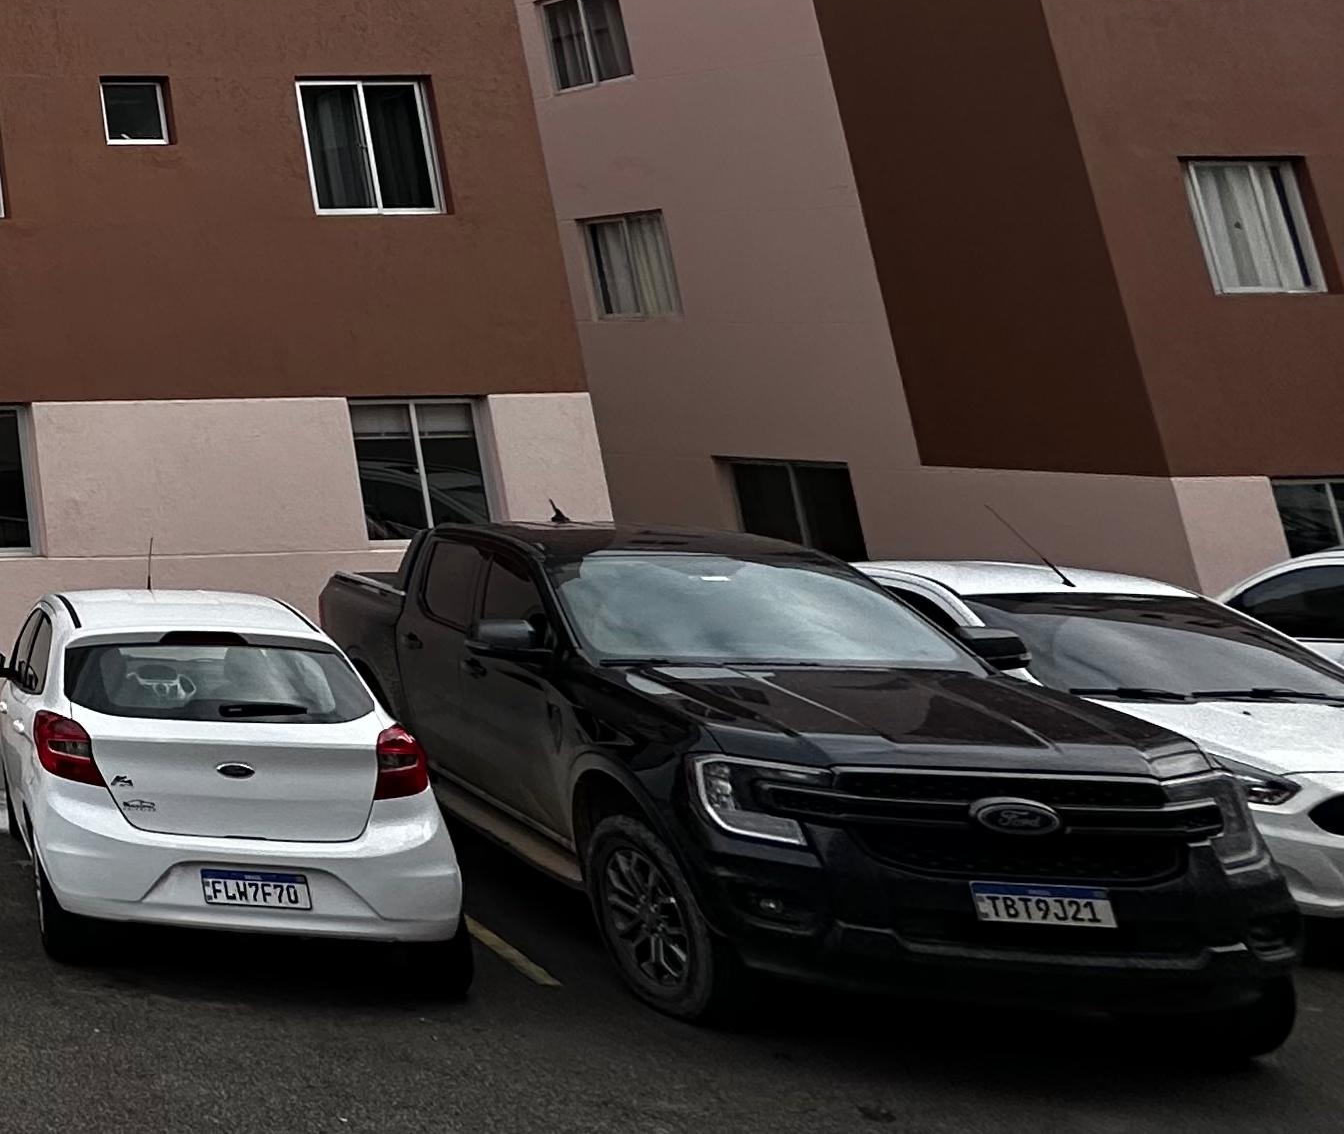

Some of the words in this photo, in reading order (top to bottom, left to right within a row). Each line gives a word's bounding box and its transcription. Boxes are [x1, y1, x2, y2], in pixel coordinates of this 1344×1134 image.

[998, 809, 1041, 827] Ford
[212, 880, 299, 905] FLW7F70
[985, 895, 1102, 923] TBT9J21
